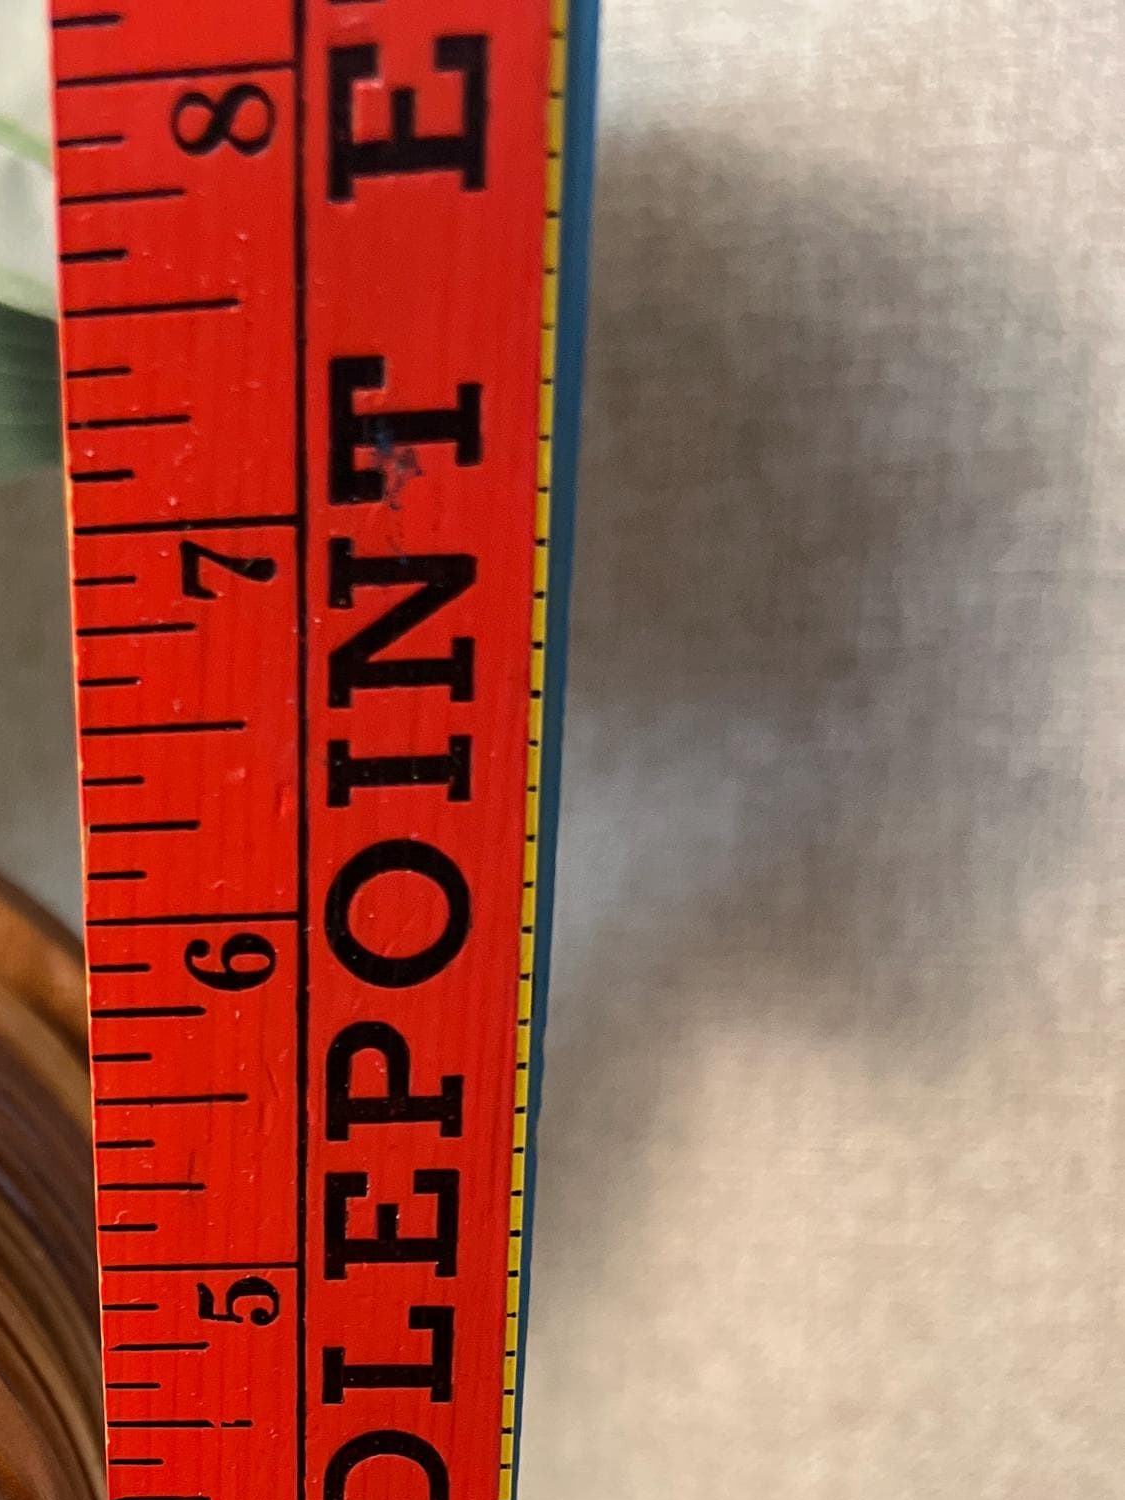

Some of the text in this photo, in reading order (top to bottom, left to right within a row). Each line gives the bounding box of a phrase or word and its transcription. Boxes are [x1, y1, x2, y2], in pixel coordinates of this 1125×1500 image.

[171, 82, 276, 157] 8
[326, 0, 489, 204] E
[179, 540, 277, 600] 7
[183, 932, 277, 992] 6
[196, 1276, 280, 1326] 5
